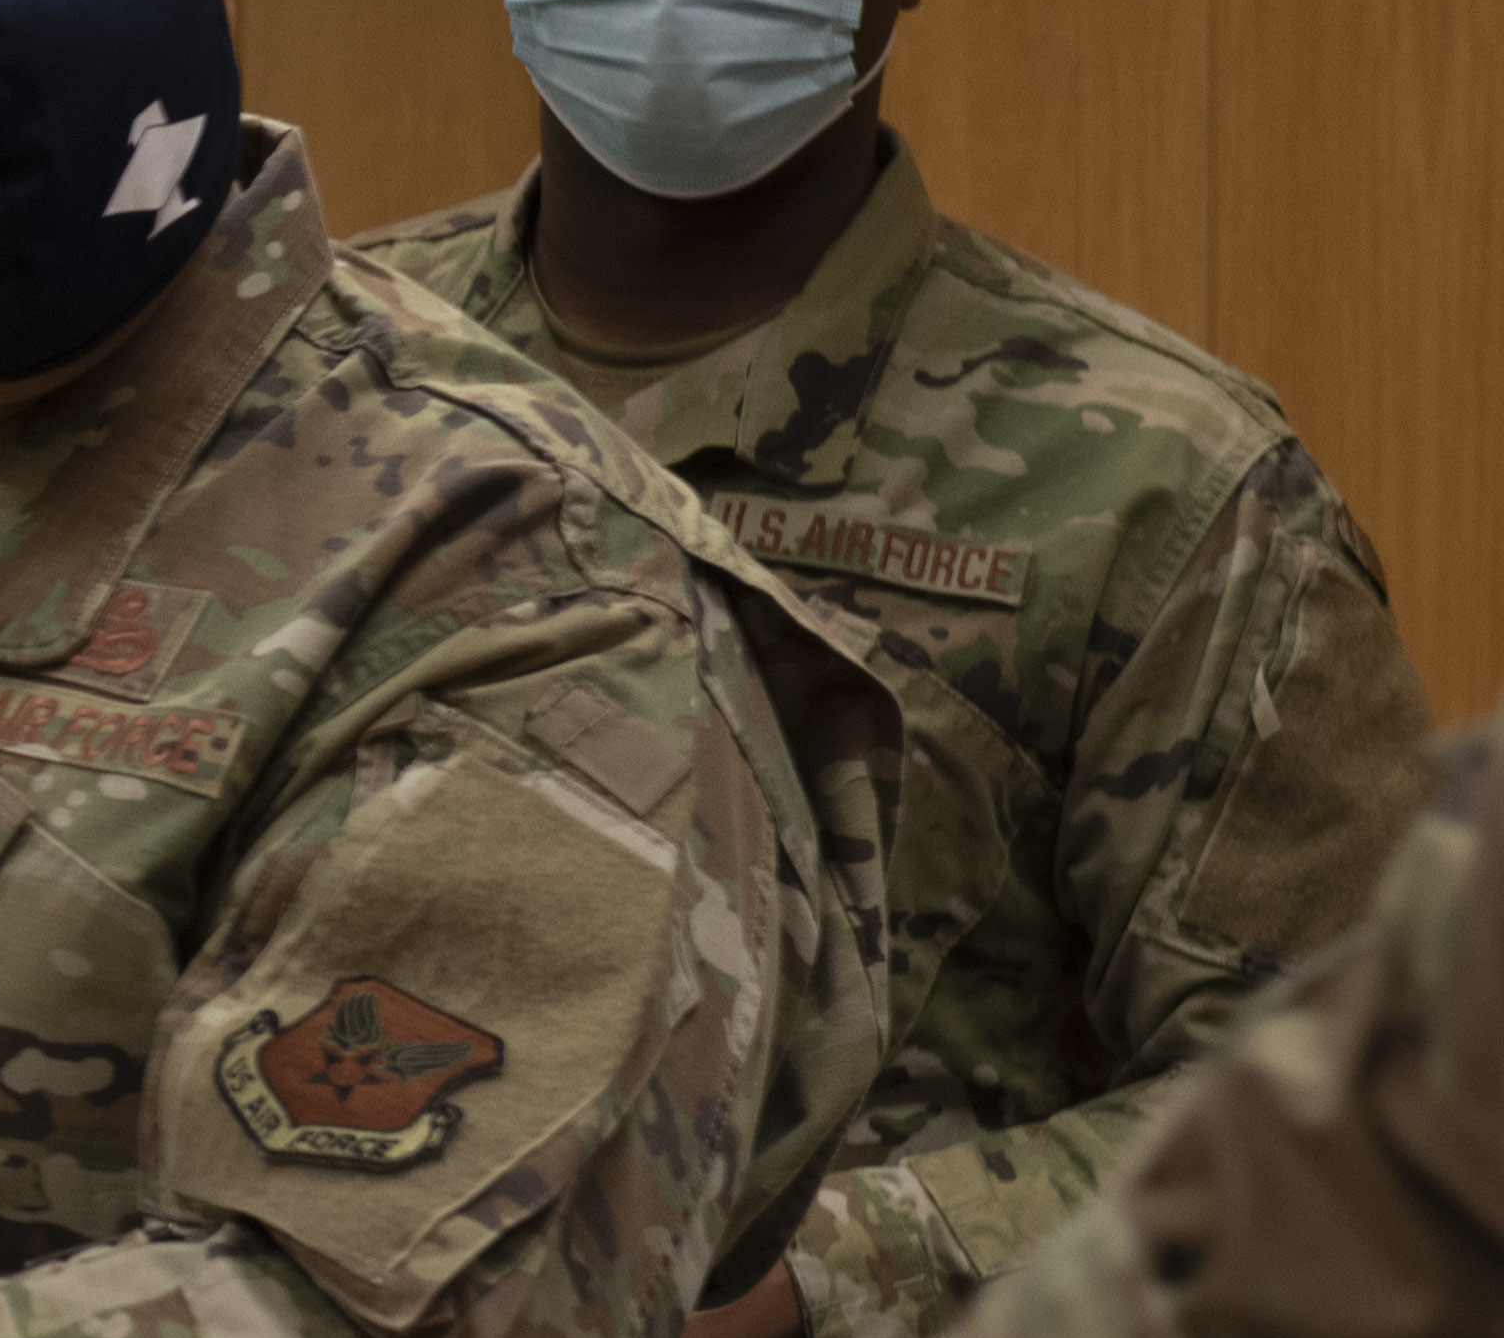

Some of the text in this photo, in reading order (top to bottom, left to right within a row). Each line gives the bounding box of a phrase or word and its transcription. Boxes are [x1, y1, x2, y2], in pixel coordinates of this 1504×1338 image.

[803, 514, 875, 566] AIR
[876, 527, 1017, 595] FORCE
[51, 707, 215, 773] FORCE
[244, 1095, 281, 1135] AIR
[284, 1130, 401, 1158] FORCE
